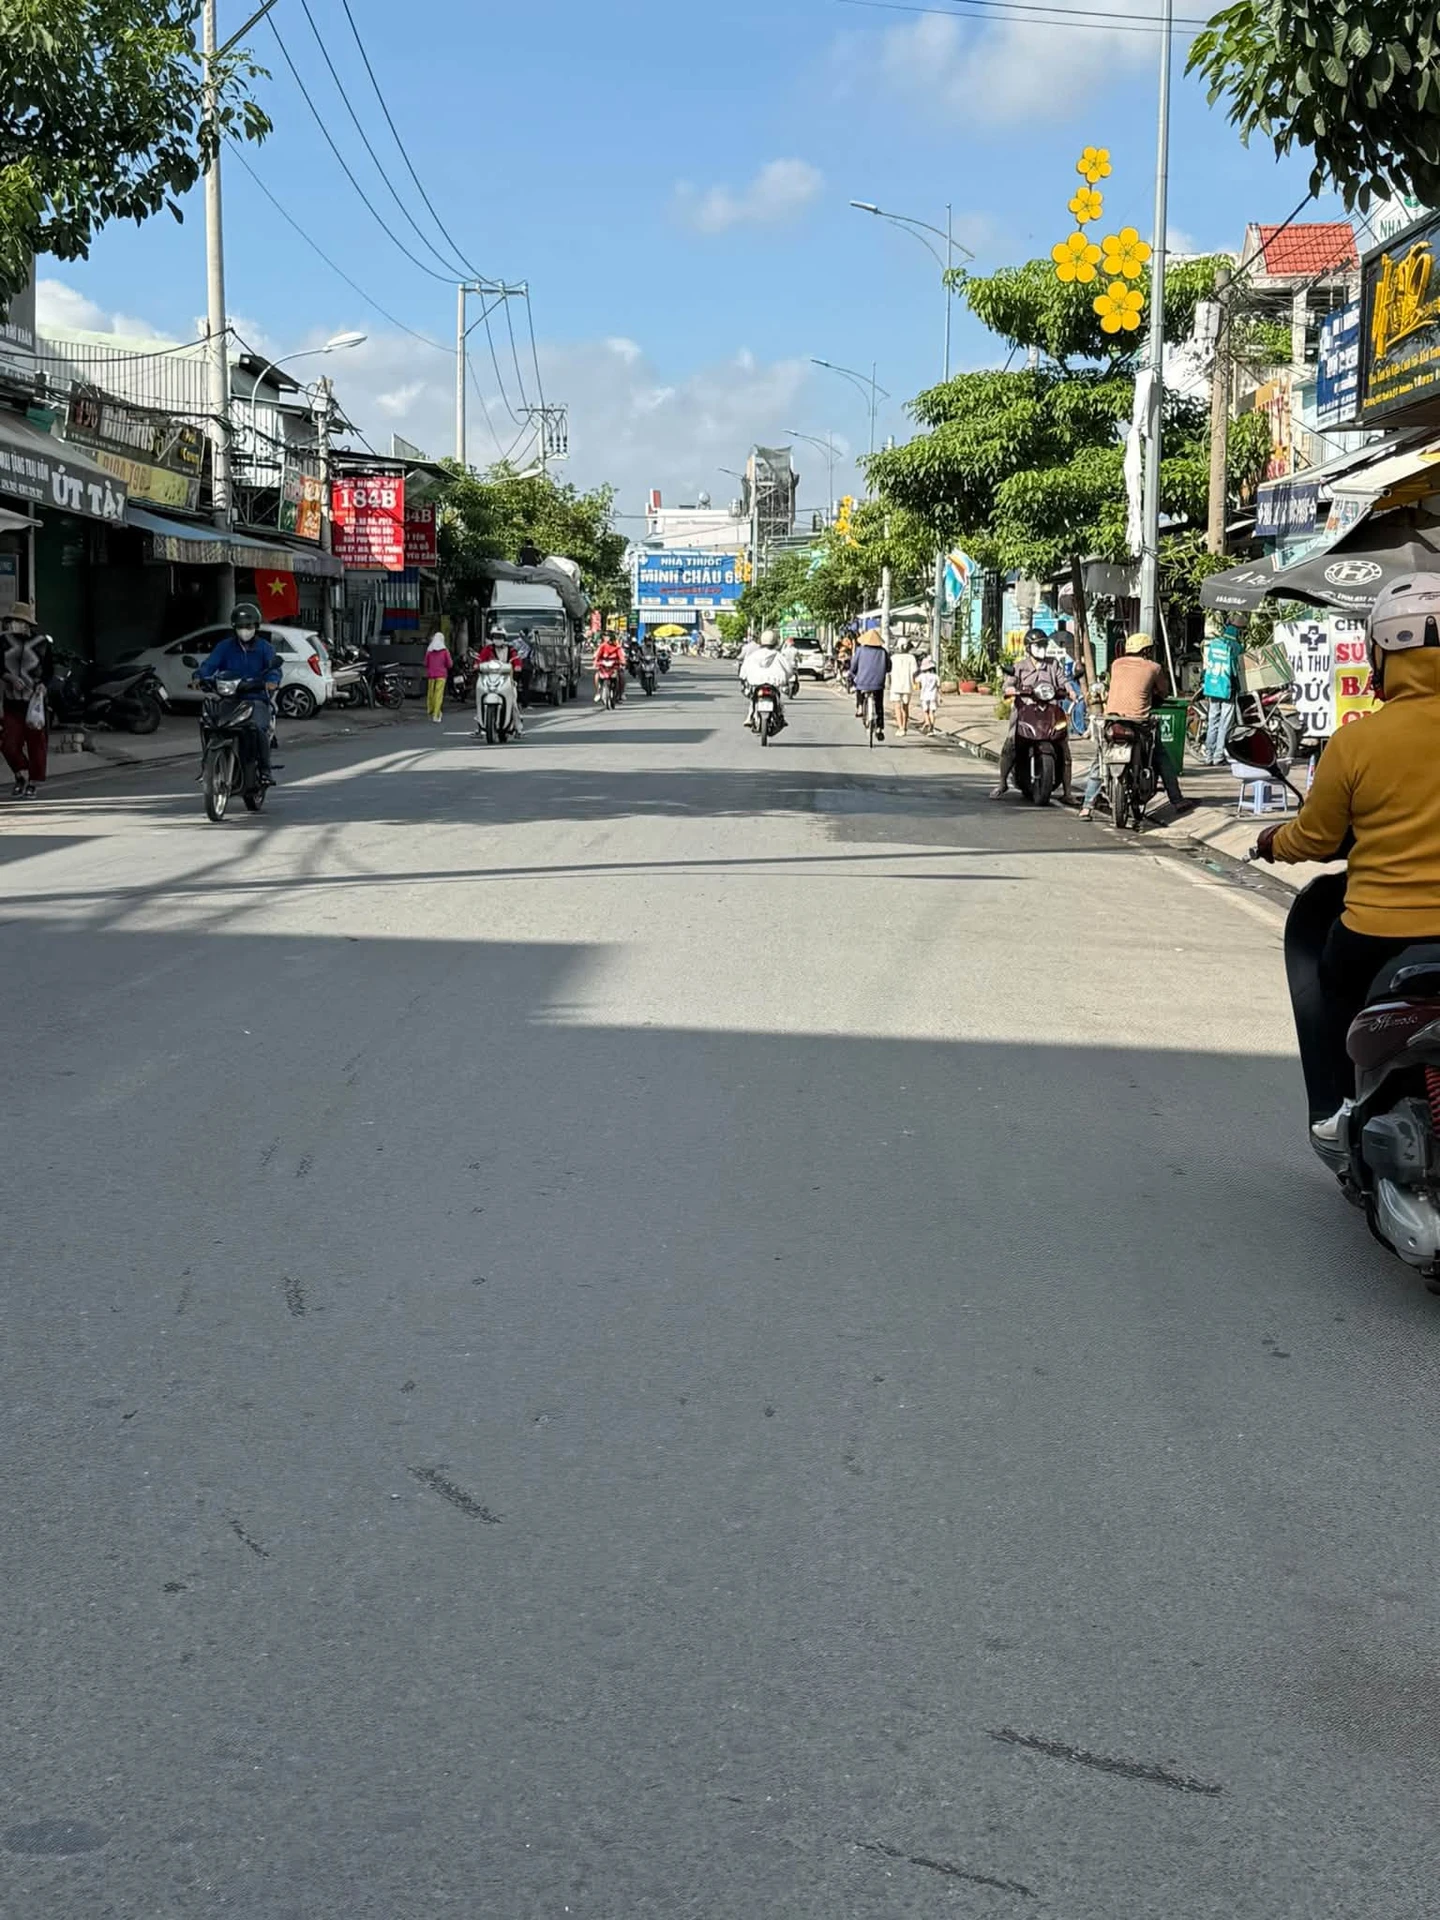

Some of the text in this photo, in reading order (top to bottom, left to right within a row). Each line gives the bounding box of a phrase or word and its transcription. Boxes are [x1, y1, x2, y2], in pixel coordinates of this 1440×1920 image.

[341, 489, 397, 508] 184B
[640, 569, 679, 583] MINH
[682, 566, 721, 584] CHÂU
